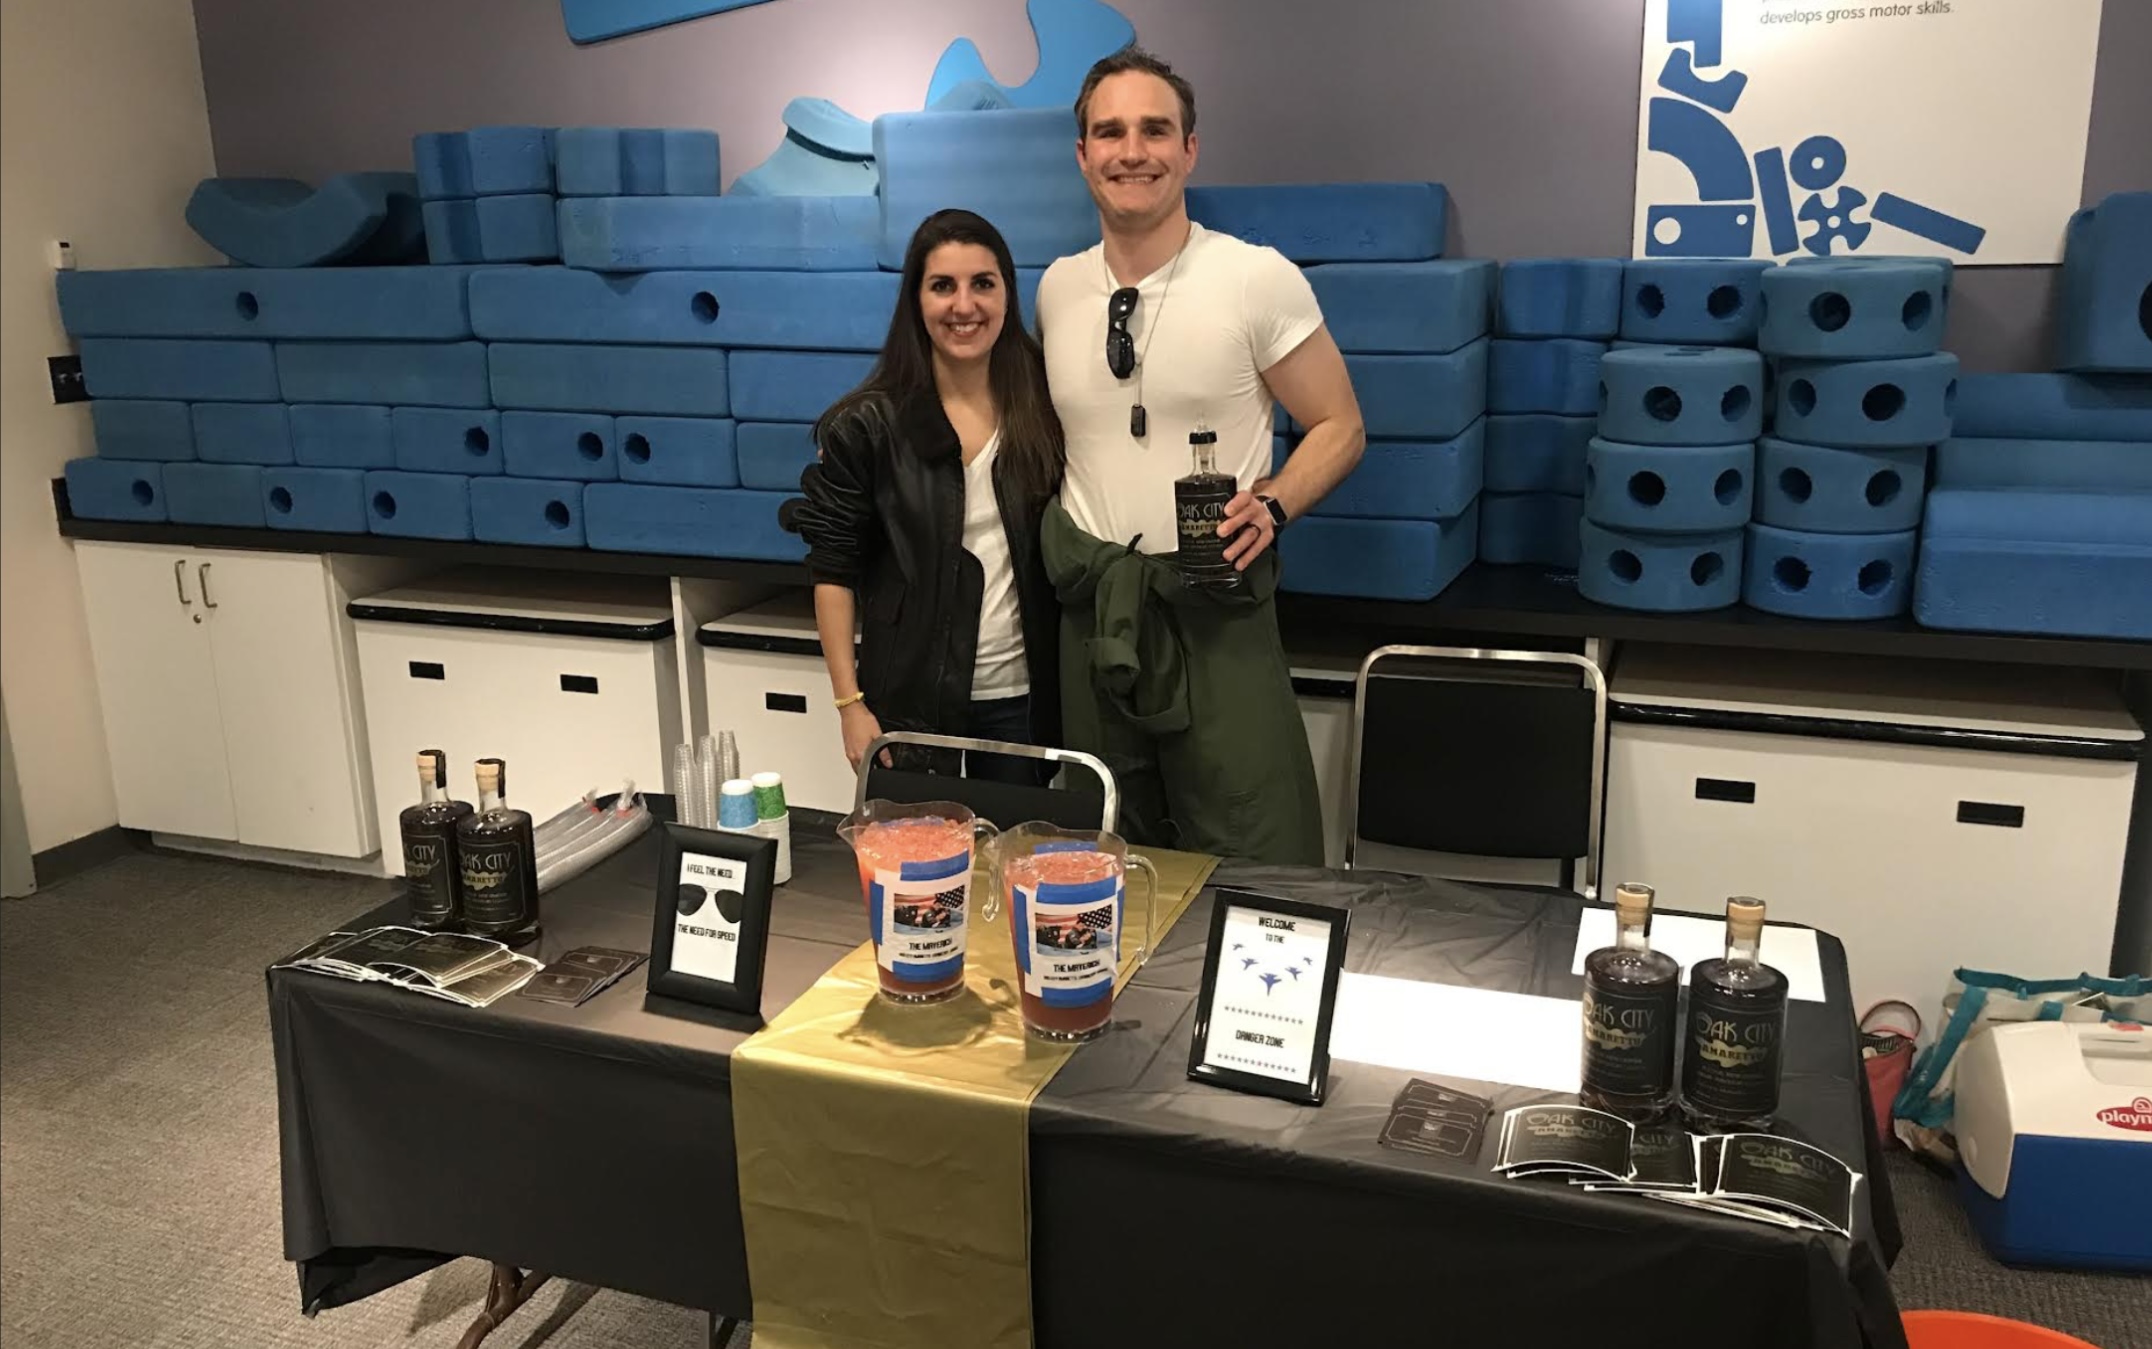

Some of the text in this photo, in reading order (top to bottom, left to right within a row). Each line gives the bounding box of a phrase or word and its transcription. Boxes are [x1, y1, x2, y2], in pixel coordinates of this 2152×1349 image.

[1760, 10, 1822, 25] develops
[1826, 8, 1865, 24] gross
[1870, 3, 1912, 18] motor
[1203, 502, 1225, 518] CITY
[411, 844, 436, 860] CITY
[485, 852, 512, 870] CITY
[690, 864, 704, 875] FEEL
[705, 866, 717, 877] THE
[677, 923, 736, 942] THE NEED FOR SPEED
[1258, 916, 1296, 932] WELCOME
[909, 942, 921, 951] THE
[1265, 933, 1285, 944] TO THE
[1053, 963, 1067, 973] THE
[1620, 1008, 1655, 1029] CITY
[1696, 1011, 1777, 1044] OAK CITY
[1235, 1029, 1285, 1049] DANGER ZONE
[1526, 1112, 1616, 1133] OAK CITY
[1639, 1133, 1674, 1145] CITY
[1740, 1142, 1838, 1177] OAK CITY
